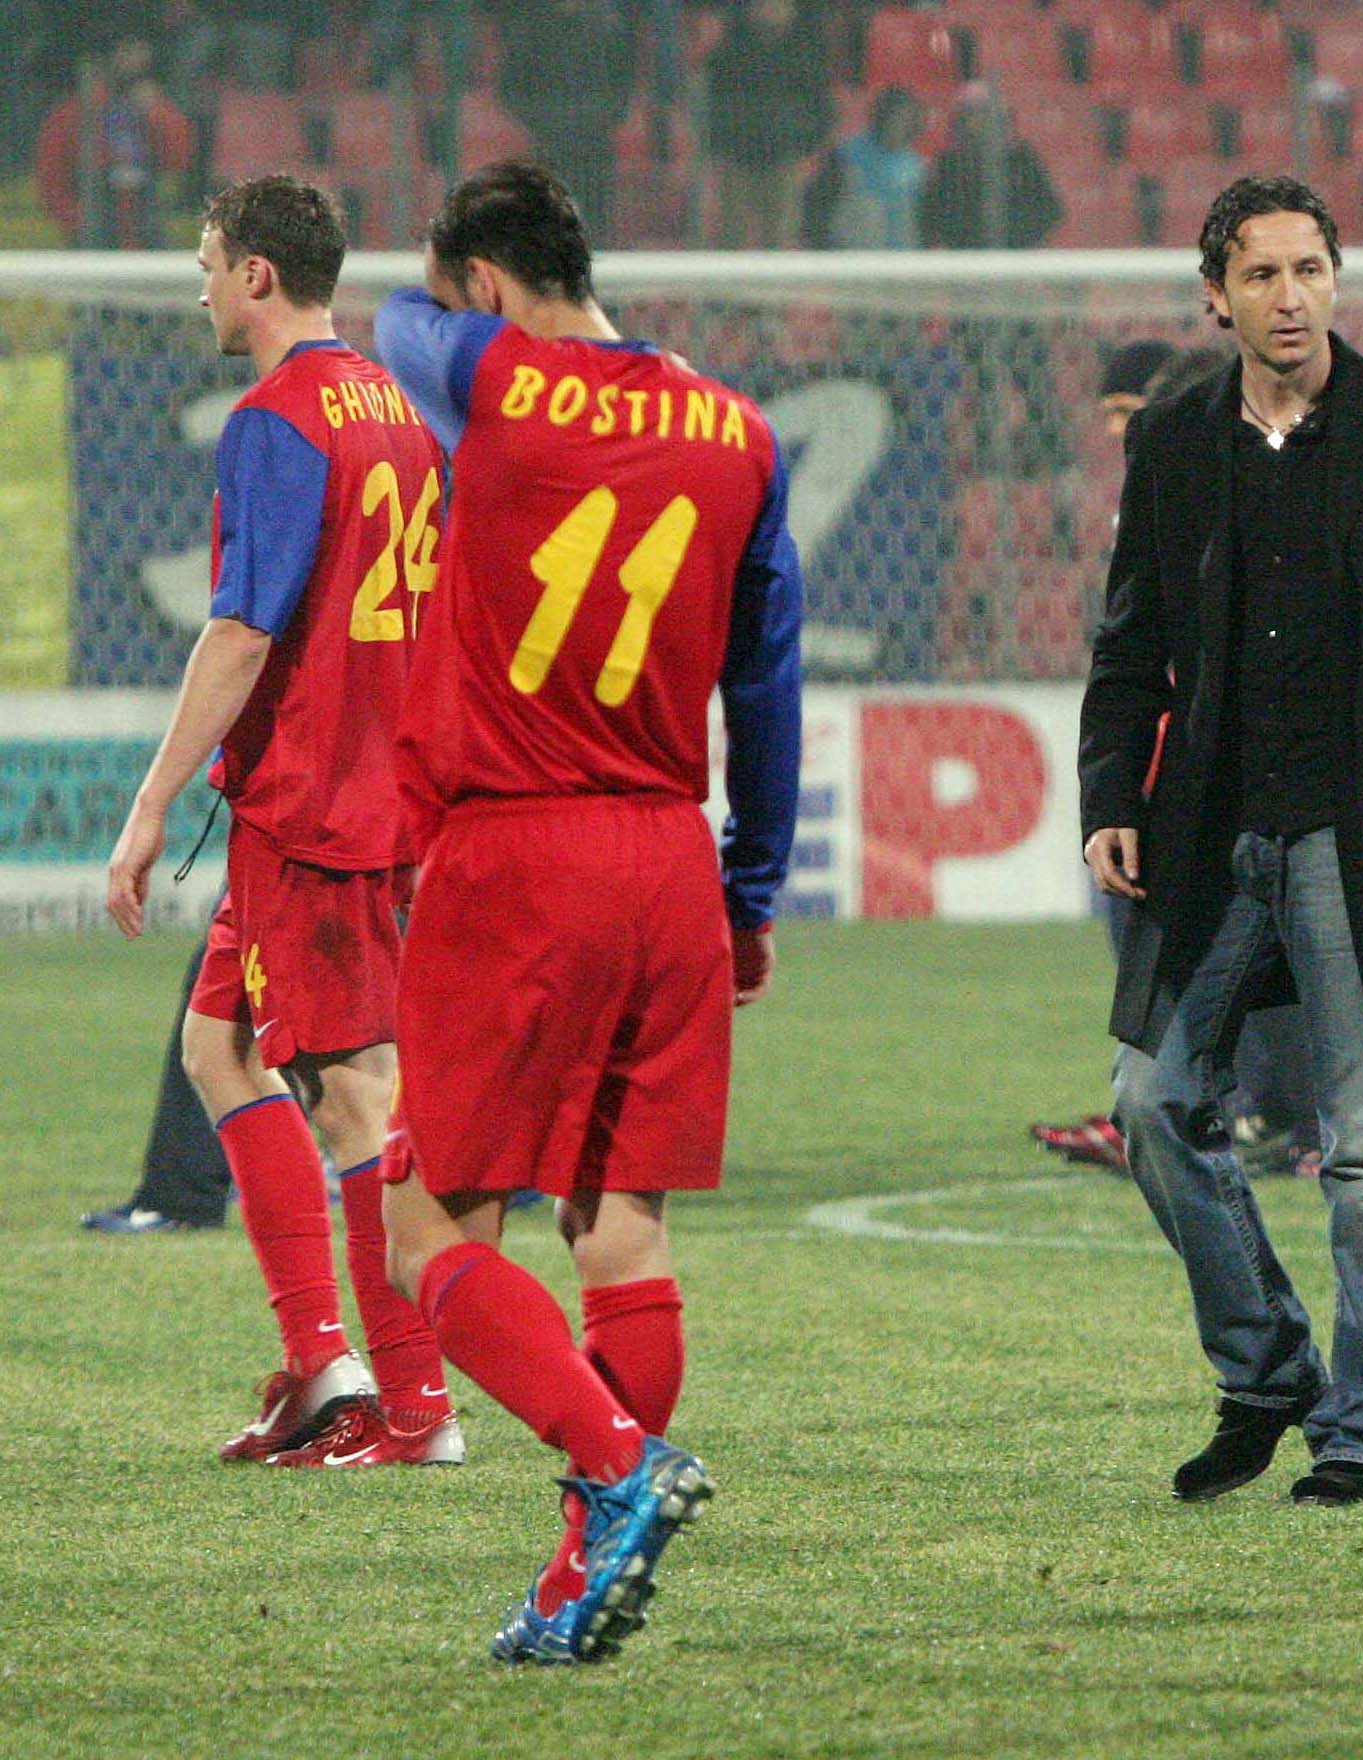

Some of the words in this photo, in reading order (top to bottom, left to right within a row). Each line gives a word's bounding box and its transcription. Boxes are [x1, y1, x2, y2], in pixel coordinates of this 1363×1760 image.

[501, 365, 746, 450] BOSTINA
[348, 460, 441, 642] 24
[508, 485, 699, 708] 11
